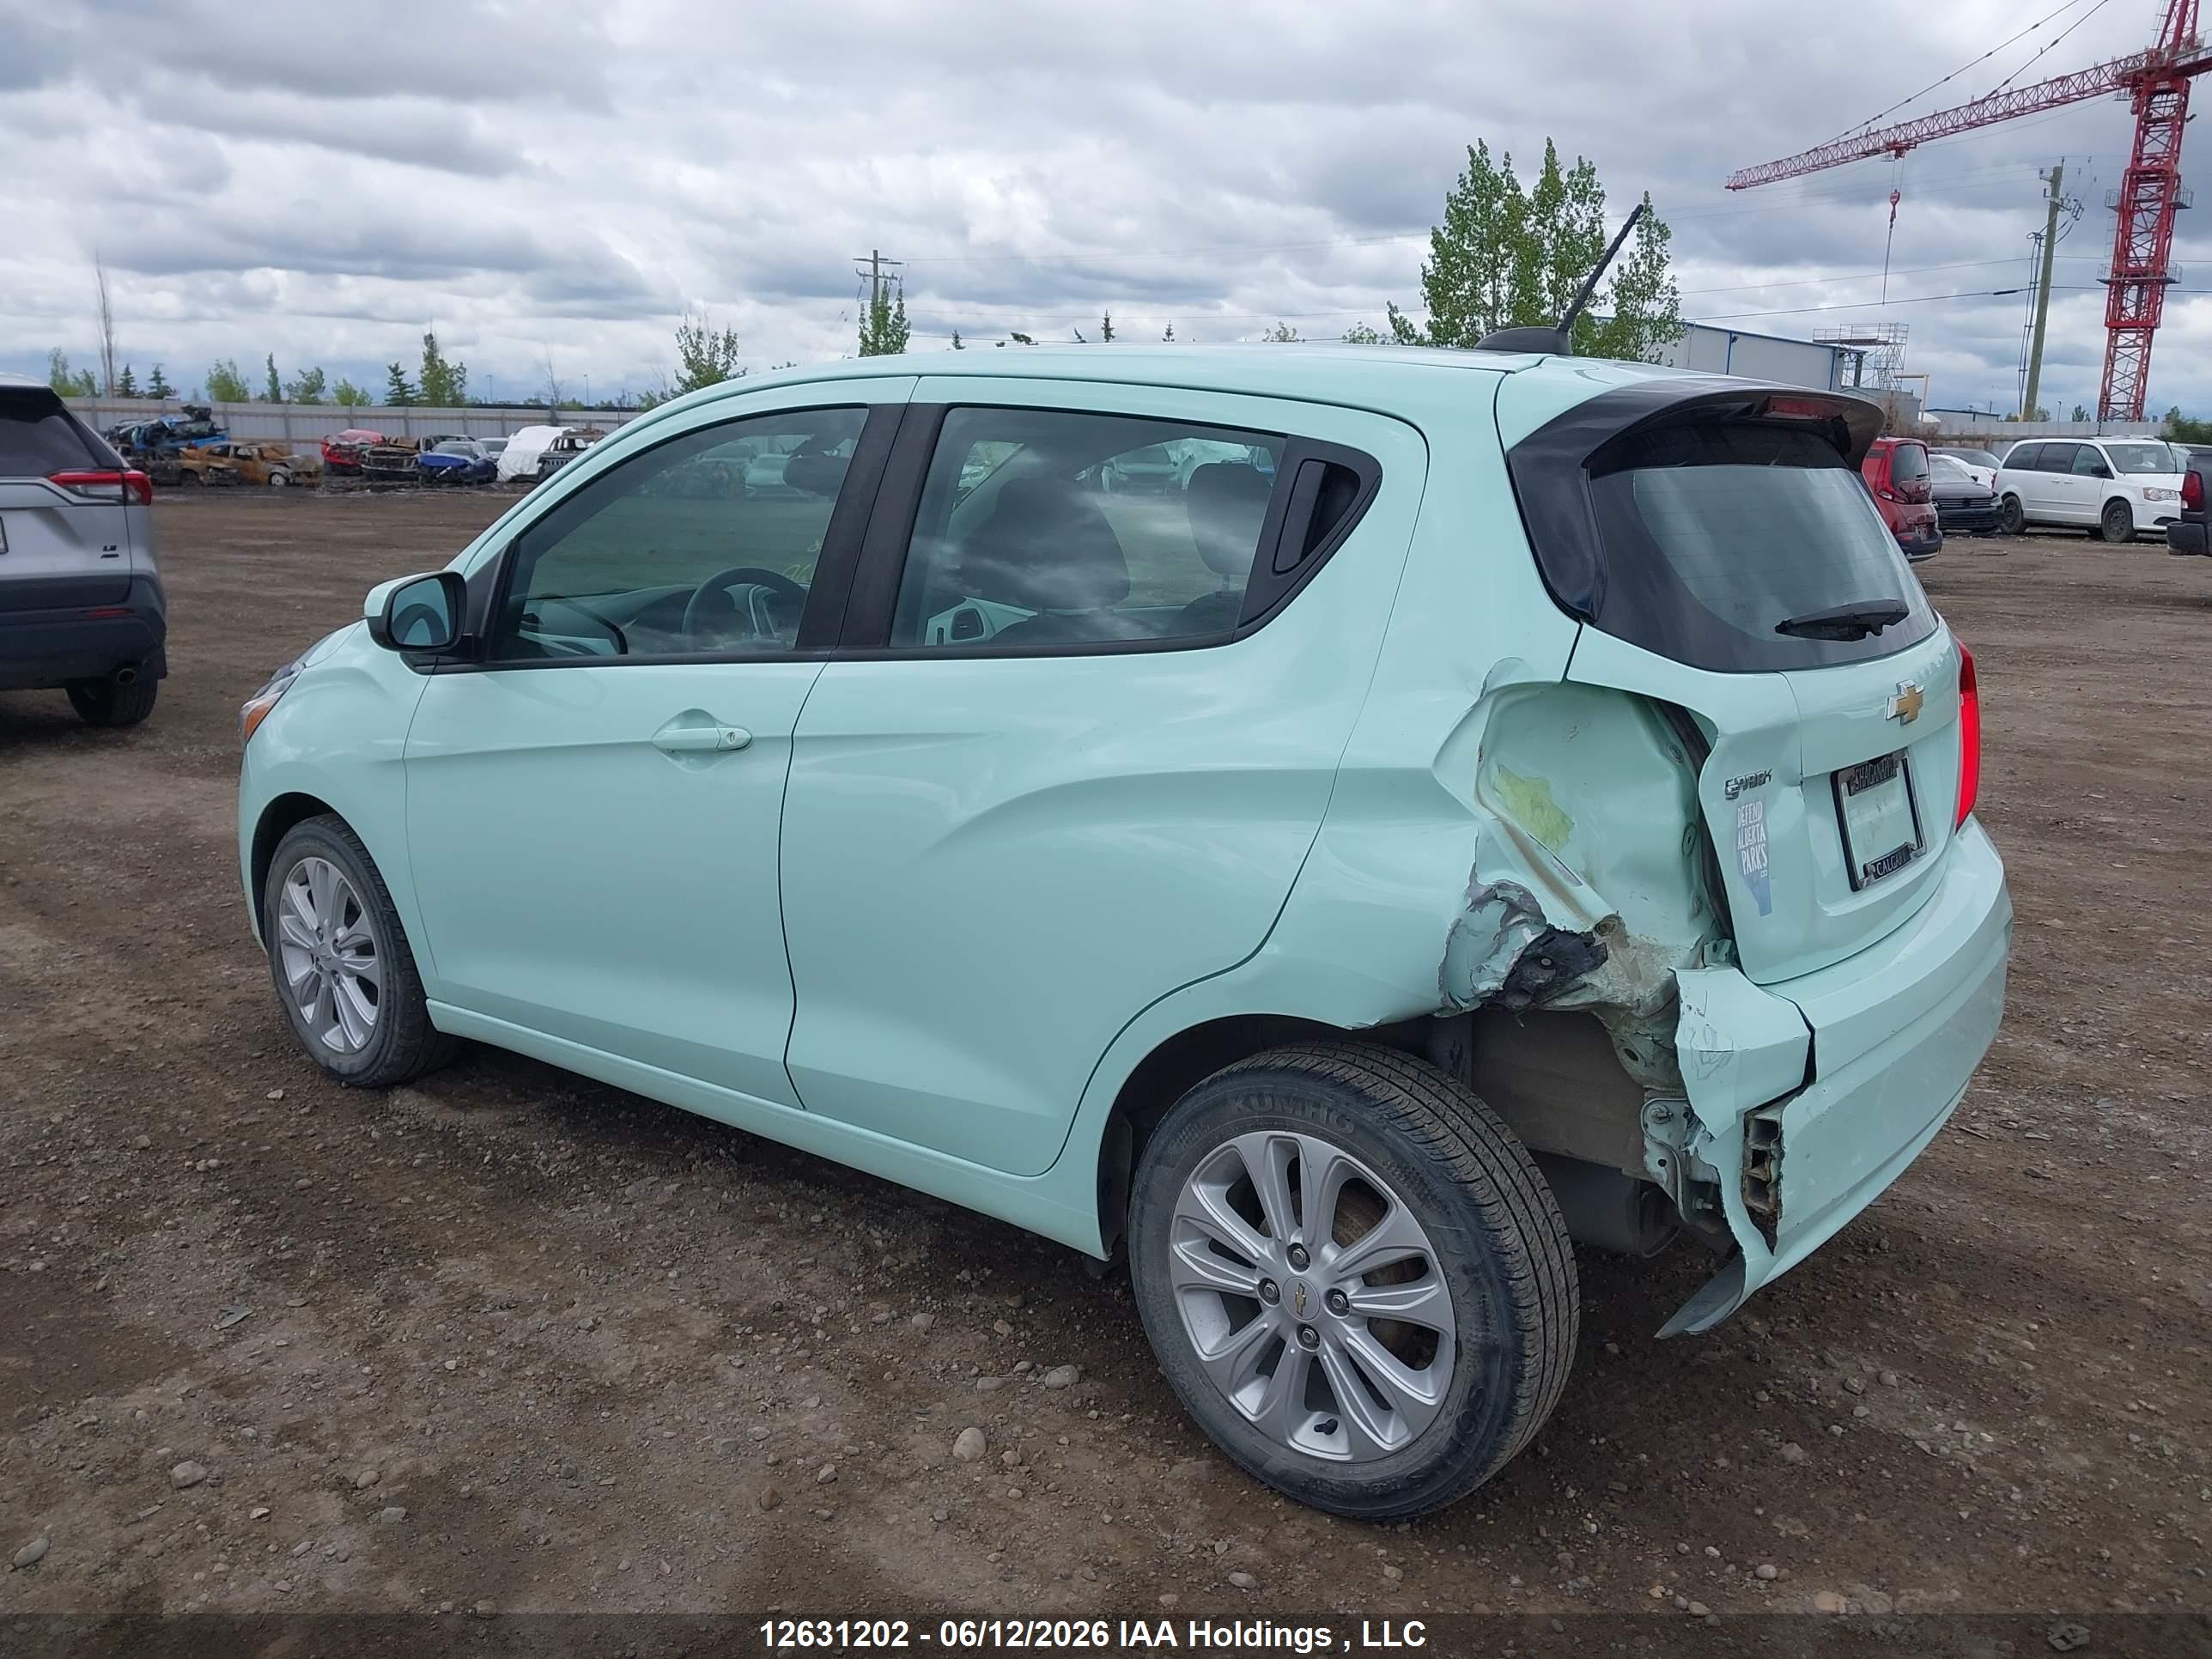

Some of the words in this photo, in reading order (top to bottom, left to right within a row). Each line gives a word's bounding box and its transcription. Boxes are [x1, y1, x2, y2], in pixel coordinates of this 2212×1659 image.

[1724, 769, 1772, 800] SPARK
[1737, 800, 1763, 828] DEFEND
[1737, 823, 1766, 850] ALBERTA
[1741, 843, 1768, 875] PARKS
[1231, 1091, 1354, 1134] KUMHO
